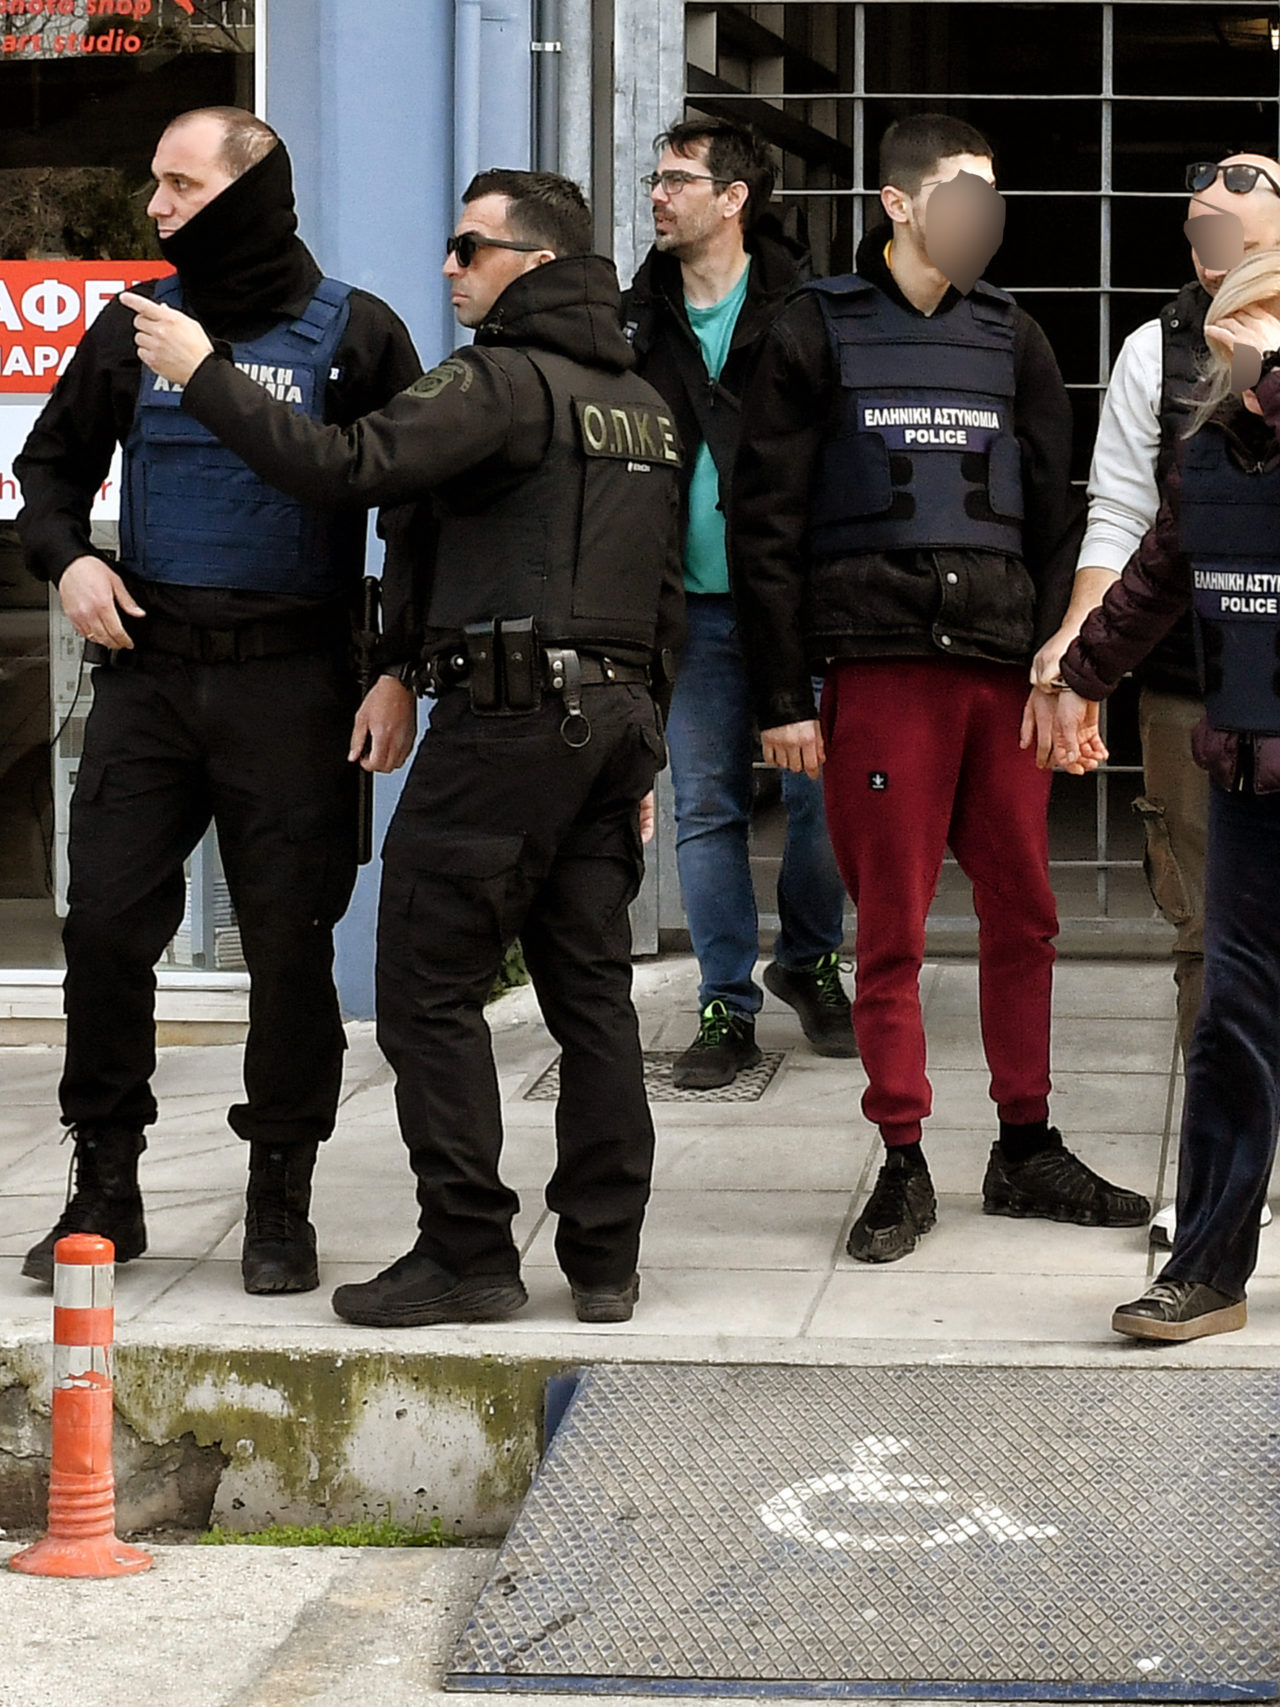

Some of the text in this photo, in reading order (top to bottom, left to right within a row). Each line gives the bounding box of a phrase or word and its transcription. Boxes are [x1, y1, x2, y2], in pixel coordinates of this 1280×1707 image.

[2, 28, 141, 53] art studio
[864, 407, 1000, 430] ΕΛΛΗΝΙΚΗ ΑΣΤΥΝΟΜΙΑ
[904, 429, 968, 445] POLICE
[1194, 570, 1245, 592] ΕΛΛΗΝΙΚΗ
[1221, 596, 1278, 614] POLICE
